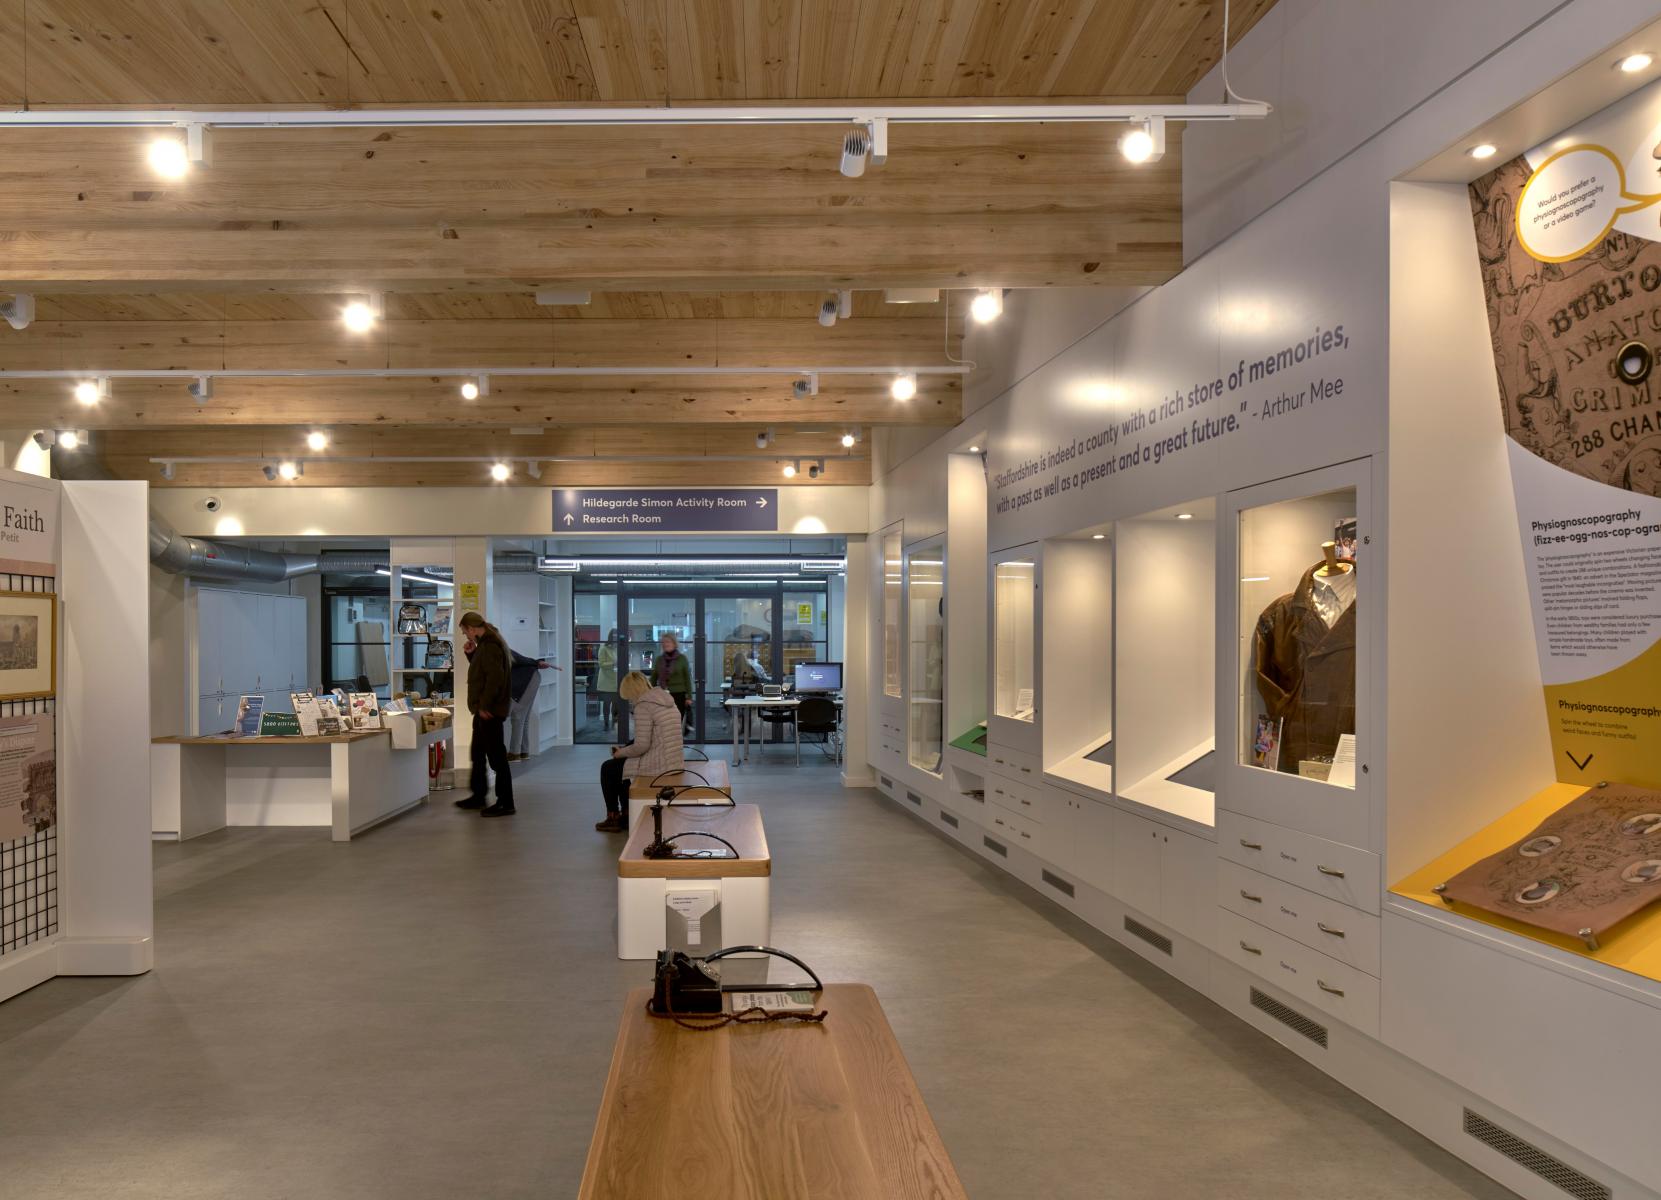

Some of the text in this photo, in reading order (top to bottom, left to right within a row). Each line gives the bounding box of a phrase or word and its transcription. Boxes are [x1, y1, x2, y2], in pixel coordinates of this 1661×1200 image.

[1538, 194, 1557, 208] Would
[1558, 190, 1570, 200] you
[1570, 179, 1589, 194] prefer
[1557, 212, 1574, 223] video
[1575, 199, 1596, 216] game?
[1040, 455, 1046, 471] is
[1048, 439, 1076, 469] indeed
[1078, 442, 1083, 455] a
[1086, 424, 1119, 452] county
[1122, 408, 1145, 436] with
[1148, 410, 1156, 425] a
[1160, 390, 1184, 421] rich
[1187, 378, 1223, 409] store
[1228, 360, 1245, 390] of
[1249, 325, 1350, 383] memories,
[1570, 380, 1661, 413] GRIM
[996, 497, 1010, 514] with
[1012, 499, 1016, 509] a
[1017, 488, 1032, 511] past
[1034, 487, 1042, 501] as
[1044, 476, 1060, 498] well
[1061, 477, 1071, 491] as
[1073, 476, 1079, 488] a
[1081, 456, 1117, 490] present
[1119, 443, 1140, 471] and
[1143, 446, 1150, 462] a
[1154, 427, 1188, 464] great
[1261, 390, 1306, 421] Arthur
[1310, 378, 1344, 404] Mee
[1571, 430, 1604, 459] 288
[583, 498, 747, 510] Hildegarde Simon Activity Room
[4, 506, 44, 532] Faith
[583, 514, 662, 524] Research Room
[1532, 508, 1641, 531] Physiognoscopography
[0, 531, 20, 543] Petit
[1534, 524, 1661, 547] (fizz-ee-ogg-nos-cop-ogra
[1559, 699, 1661, 718] Physiognoscopograph
